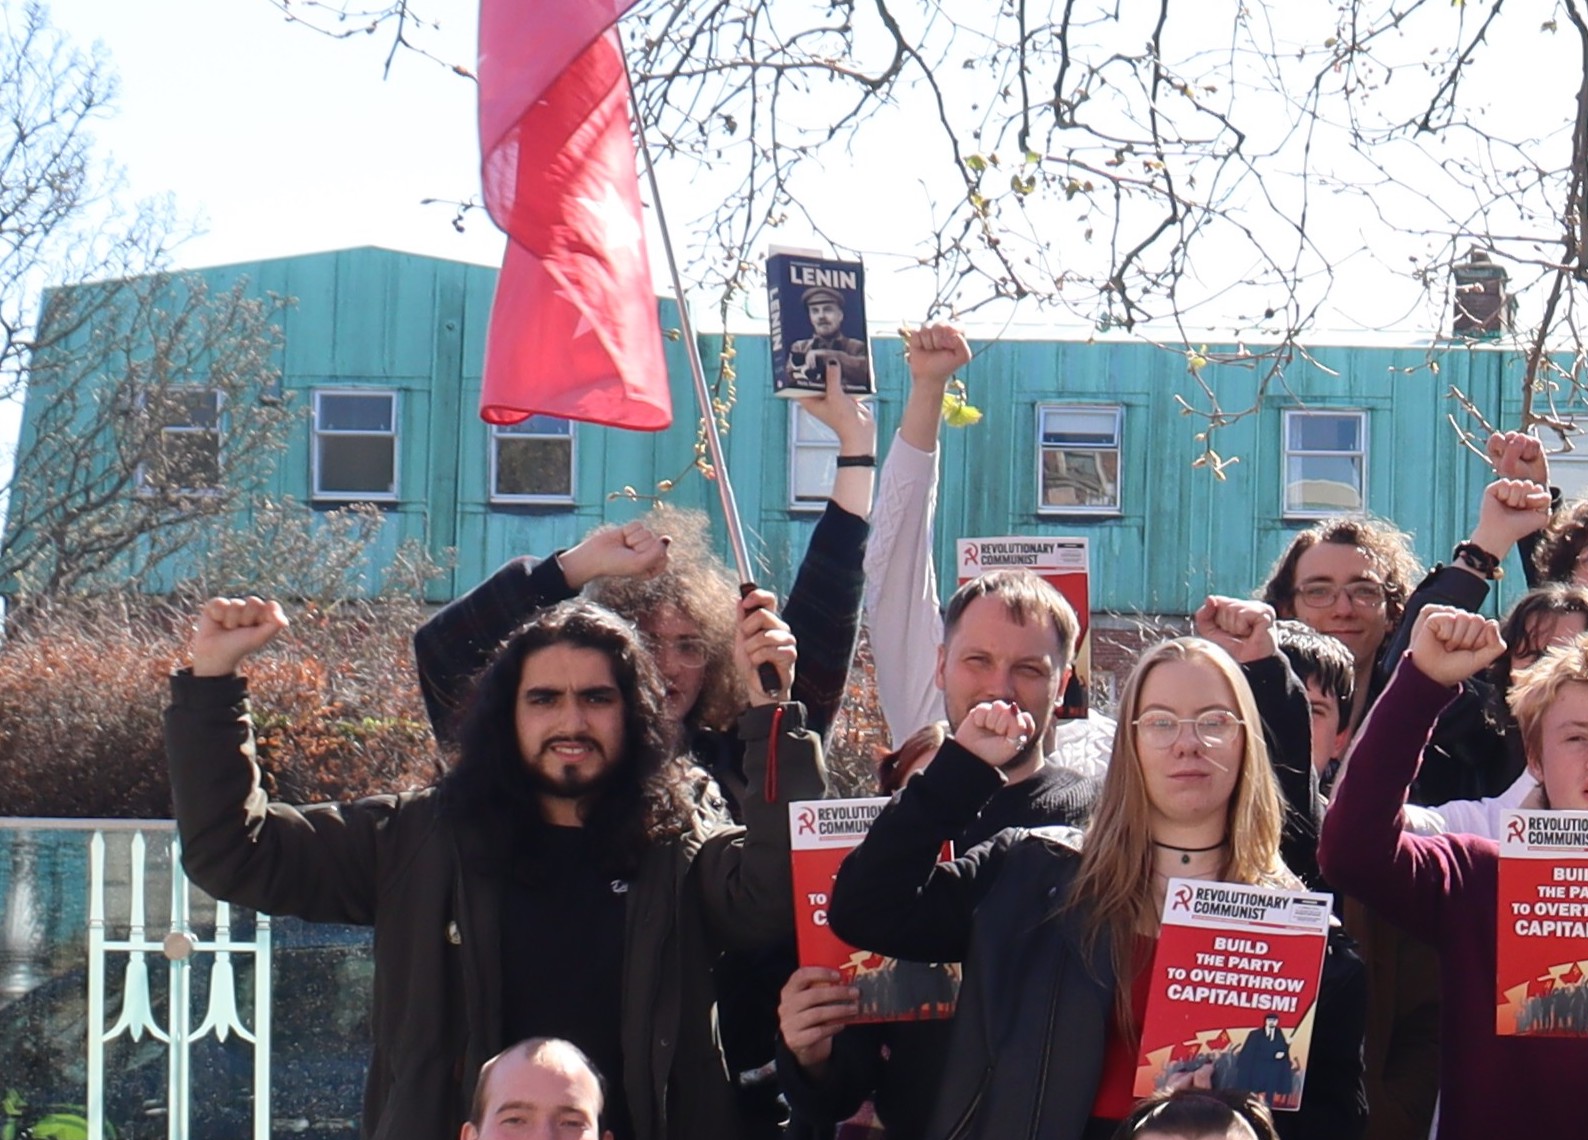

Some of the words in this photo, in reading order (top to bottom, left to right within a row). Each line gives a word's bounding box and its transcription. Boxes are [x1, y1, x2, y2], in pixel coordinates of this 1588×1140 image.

[790, 265, 856, 290] LENIN
[770, 287, 782, 351] LENIN
[981, 543, 1054, 554] REVOLUTIONARY
[981, 554, 1038, 565] COMMUNIST
[818, 805, 885, 820] REVOLUTIO
[819, 820, 872, 834] COMMUN
[808, 893, 827, 905] TO
[1196, 888, 1290, 910] REVOLUTIONARY
[1537, 886, 1565, 898] THE
[1193, 901, 1266, 920] COMMUNIST
[1512, 903, 1530, 915] TO
[1214, 937, 1268, 955] BUILD
[1196, 953, 1225, 967] THE
[1228, 957, 1283, 973] PARTY
[1167, 968, 1186, 980] TO
[1190, 970, 1304, 993] OVERTHROW
[1167, 984, 1298, 1012] CAPITALISM!
